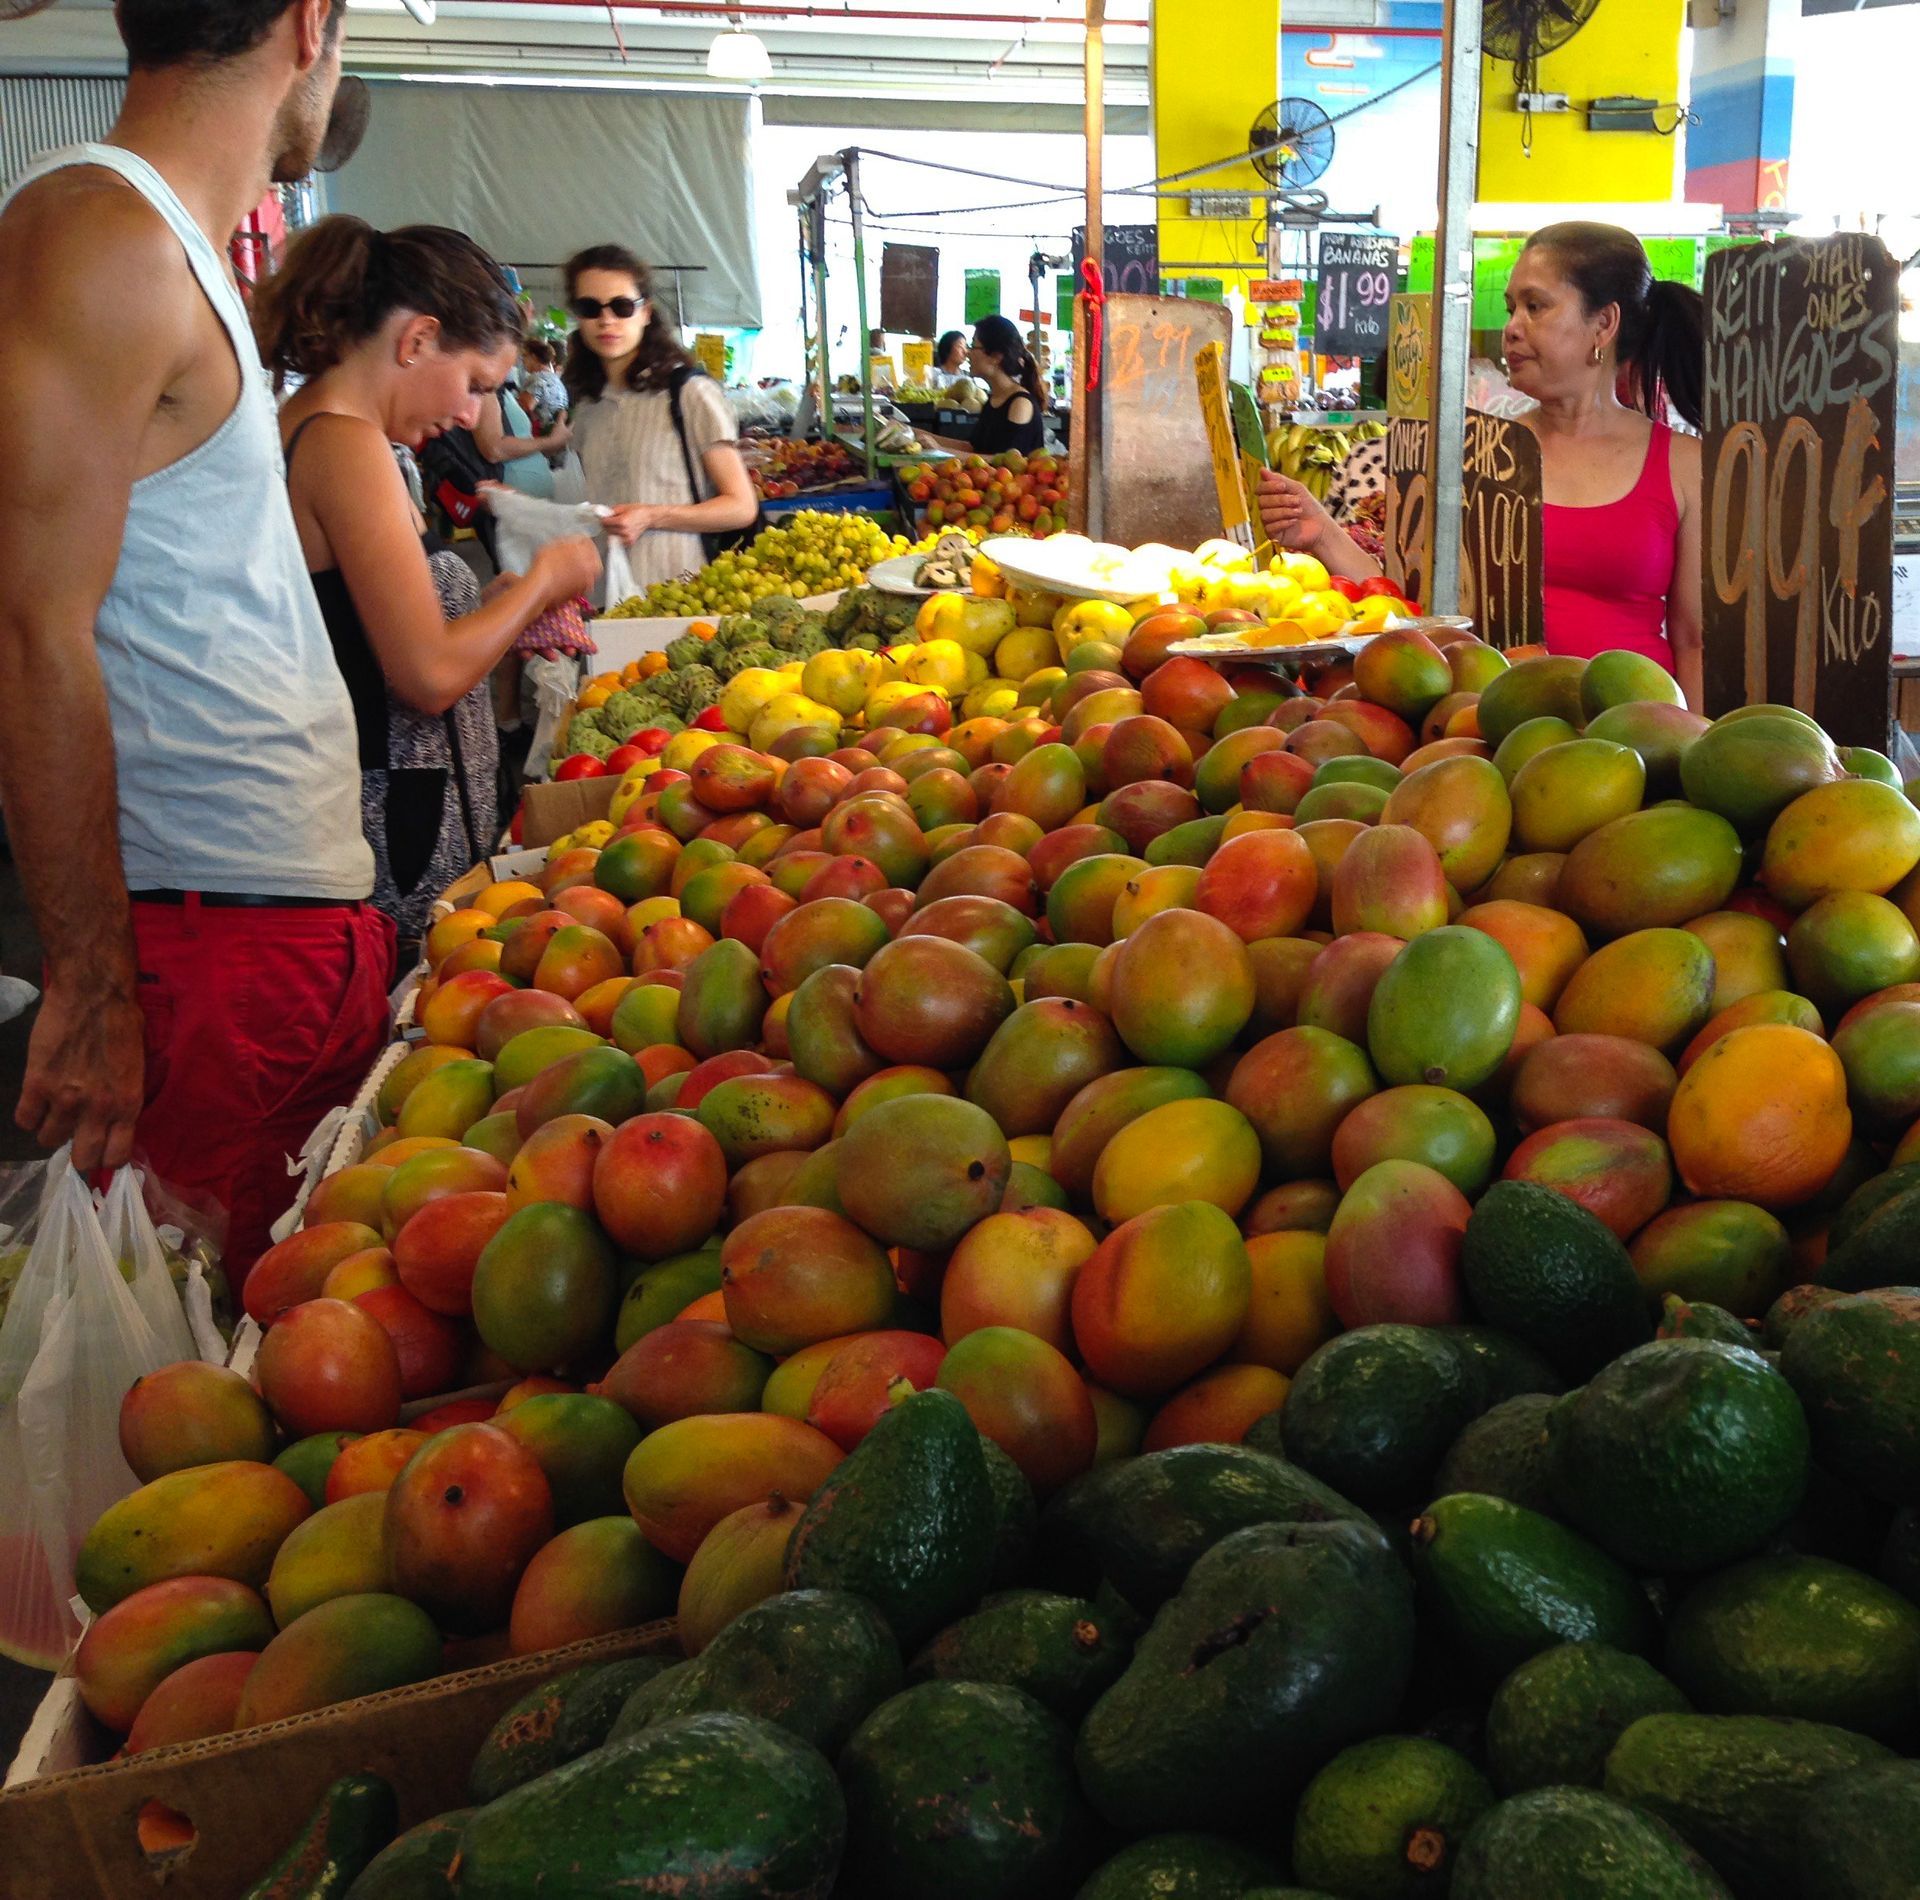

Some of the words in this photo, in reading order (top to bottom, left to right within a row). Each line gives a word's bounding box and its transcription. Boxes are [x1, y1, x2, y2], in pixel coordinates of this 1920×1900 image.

[1323, 245, 1390, 268] BANANAS
[1806, 282, 1873, 332] ONES
[1704, 311, 1894, 432] MANGOES
